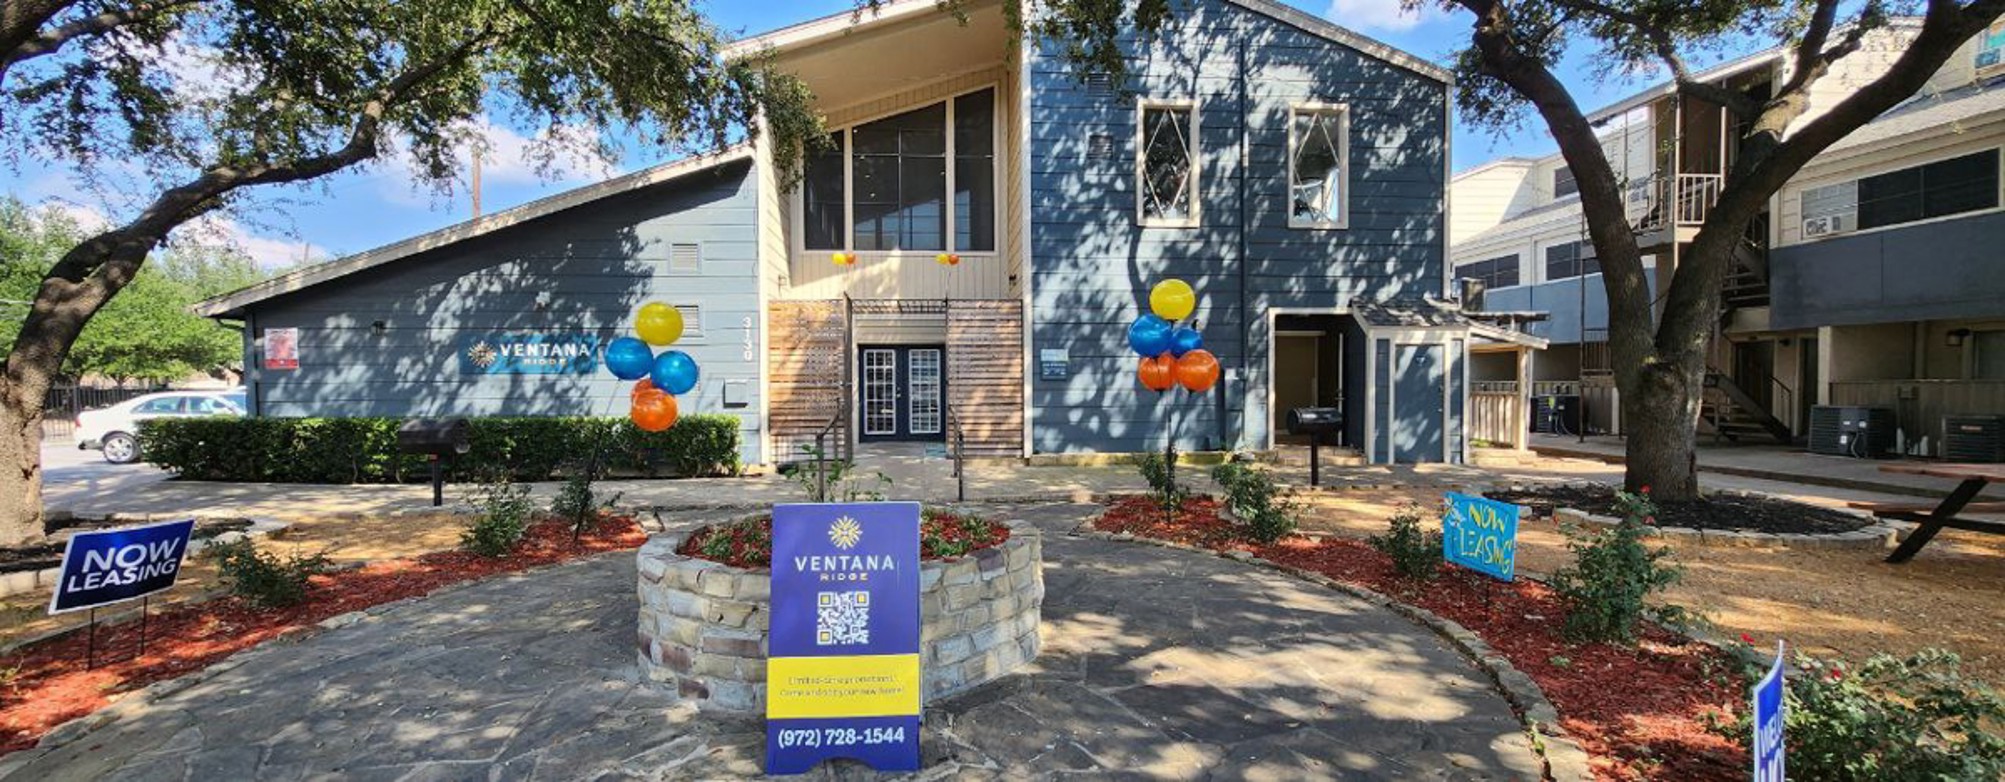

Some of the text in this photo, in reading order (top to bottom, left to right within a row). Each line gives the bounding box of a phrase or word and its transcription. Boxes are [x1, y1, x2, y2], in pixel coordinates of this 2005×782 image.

[500, 343, 590, 357] VENTANA
[1469, 502, 1509, 534] NOW
[82, 537, 180, 573] NOW
[795, 555, 895, 572] VENTANA
[1460, 528, 1512, 574] LEASING
[67, 558, 178, 593] LEASING
[820, 573, 868, 581] RIDGE
[778, 727, 905, 748] (972) 728-1544
